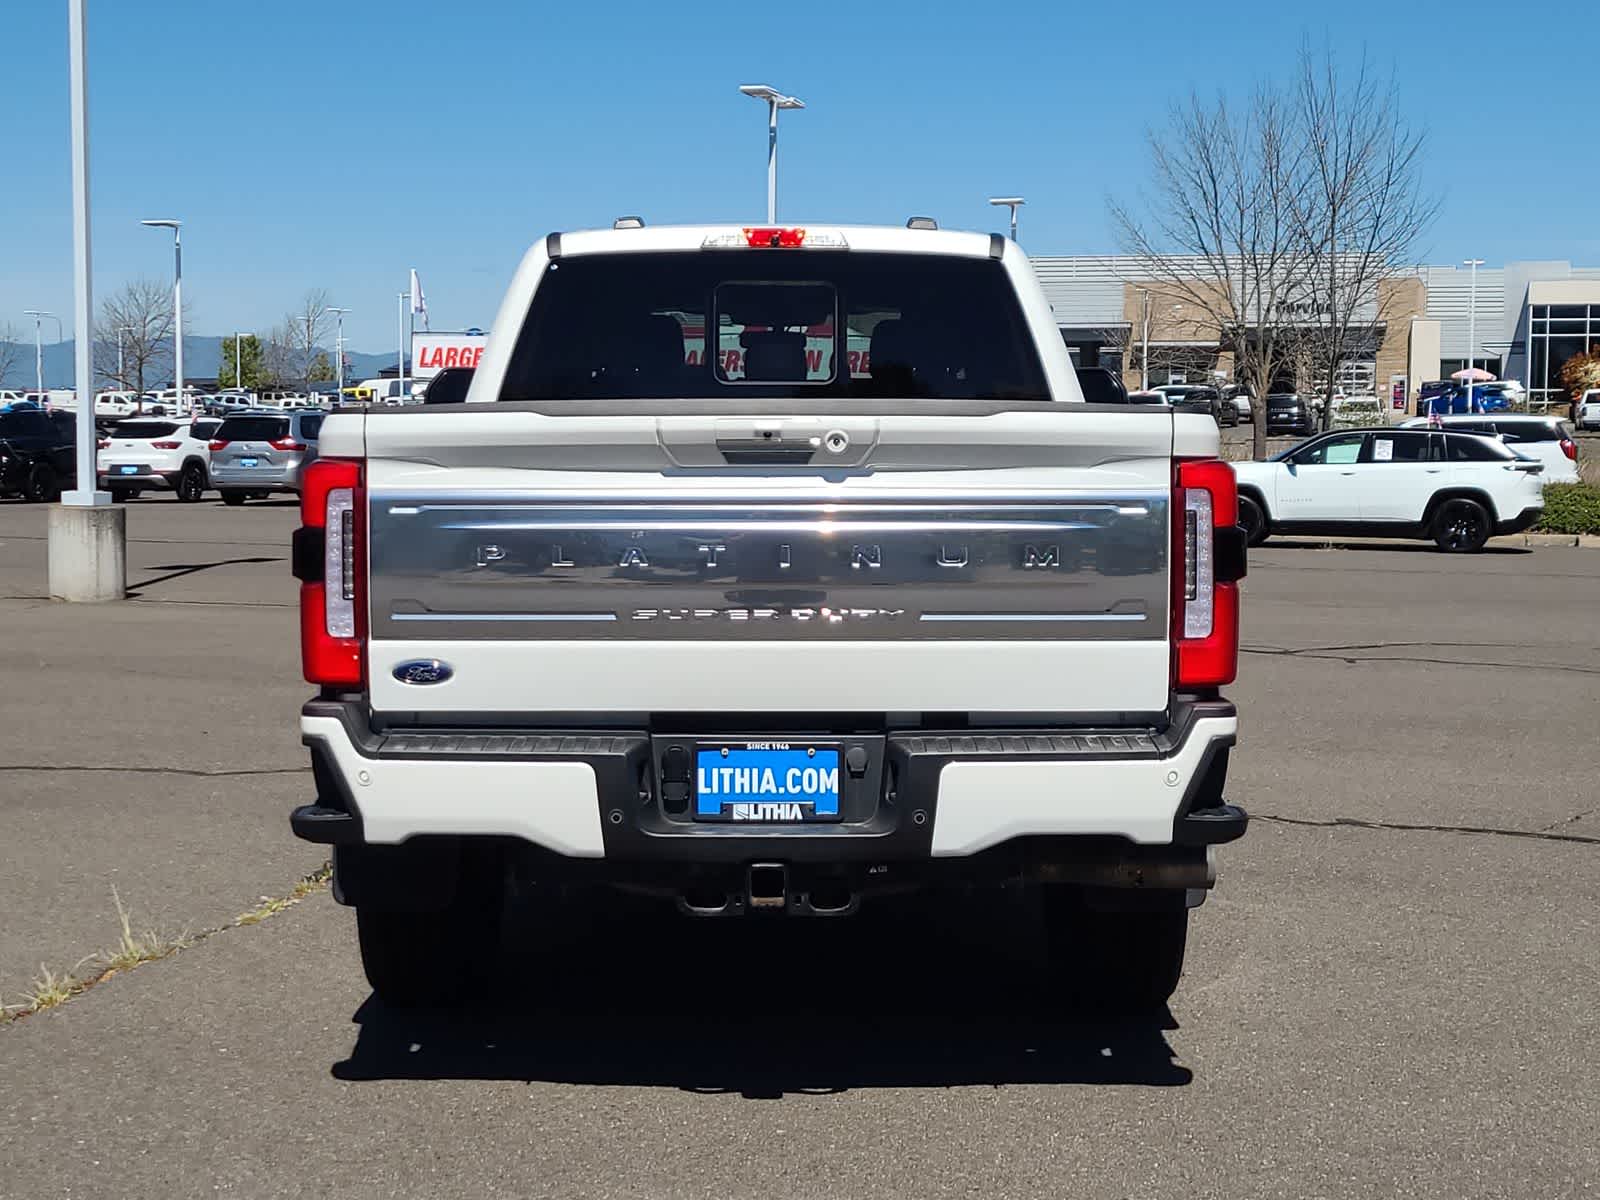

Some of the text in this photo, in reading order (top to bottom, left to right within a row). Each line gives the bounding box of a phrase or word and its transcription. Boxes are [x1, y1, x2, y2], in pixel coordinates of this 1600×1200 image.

[476, 545, 1059, 567] PLATINUM
[632, 607, 904, 621] SUPER DUTY
[407, 666, 440, 681] Ford
[746, 742, 790, 750] SINCE 1946
[698, 767, 839, 794] LITHIA.COM
[750, 804, 803, 820] LITHIA
